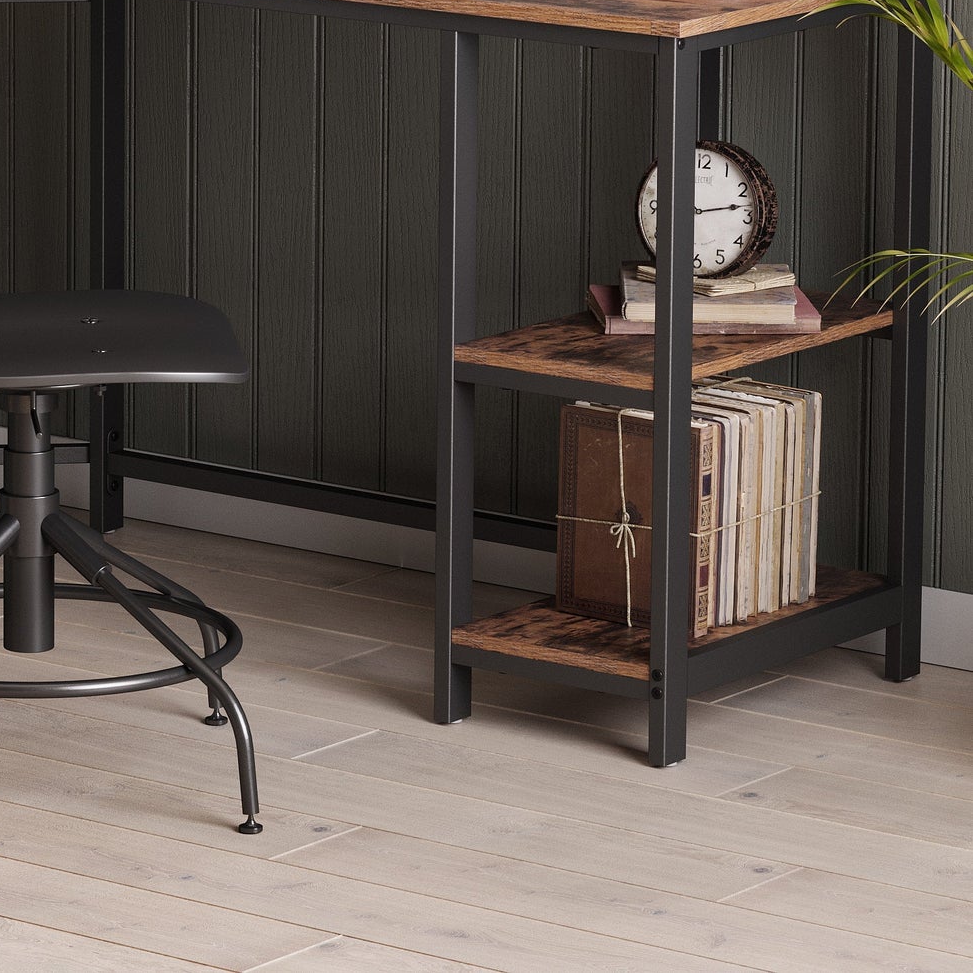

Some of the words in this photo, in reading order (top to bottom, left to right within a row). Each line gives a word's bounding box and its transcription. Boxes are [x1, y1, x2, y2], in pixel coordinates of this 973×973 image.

[697, 153, 711, 169] 12
[725, 163, 729, 178] 1
[738, 182, 747, 197] 2
[649, 200, 657, 214] 9
[742, 209, 753, 224] 3
[733, 234, 744, 248] 4
[693, 253, 702, 269] 6
[715, 249, 725, 265] 5
